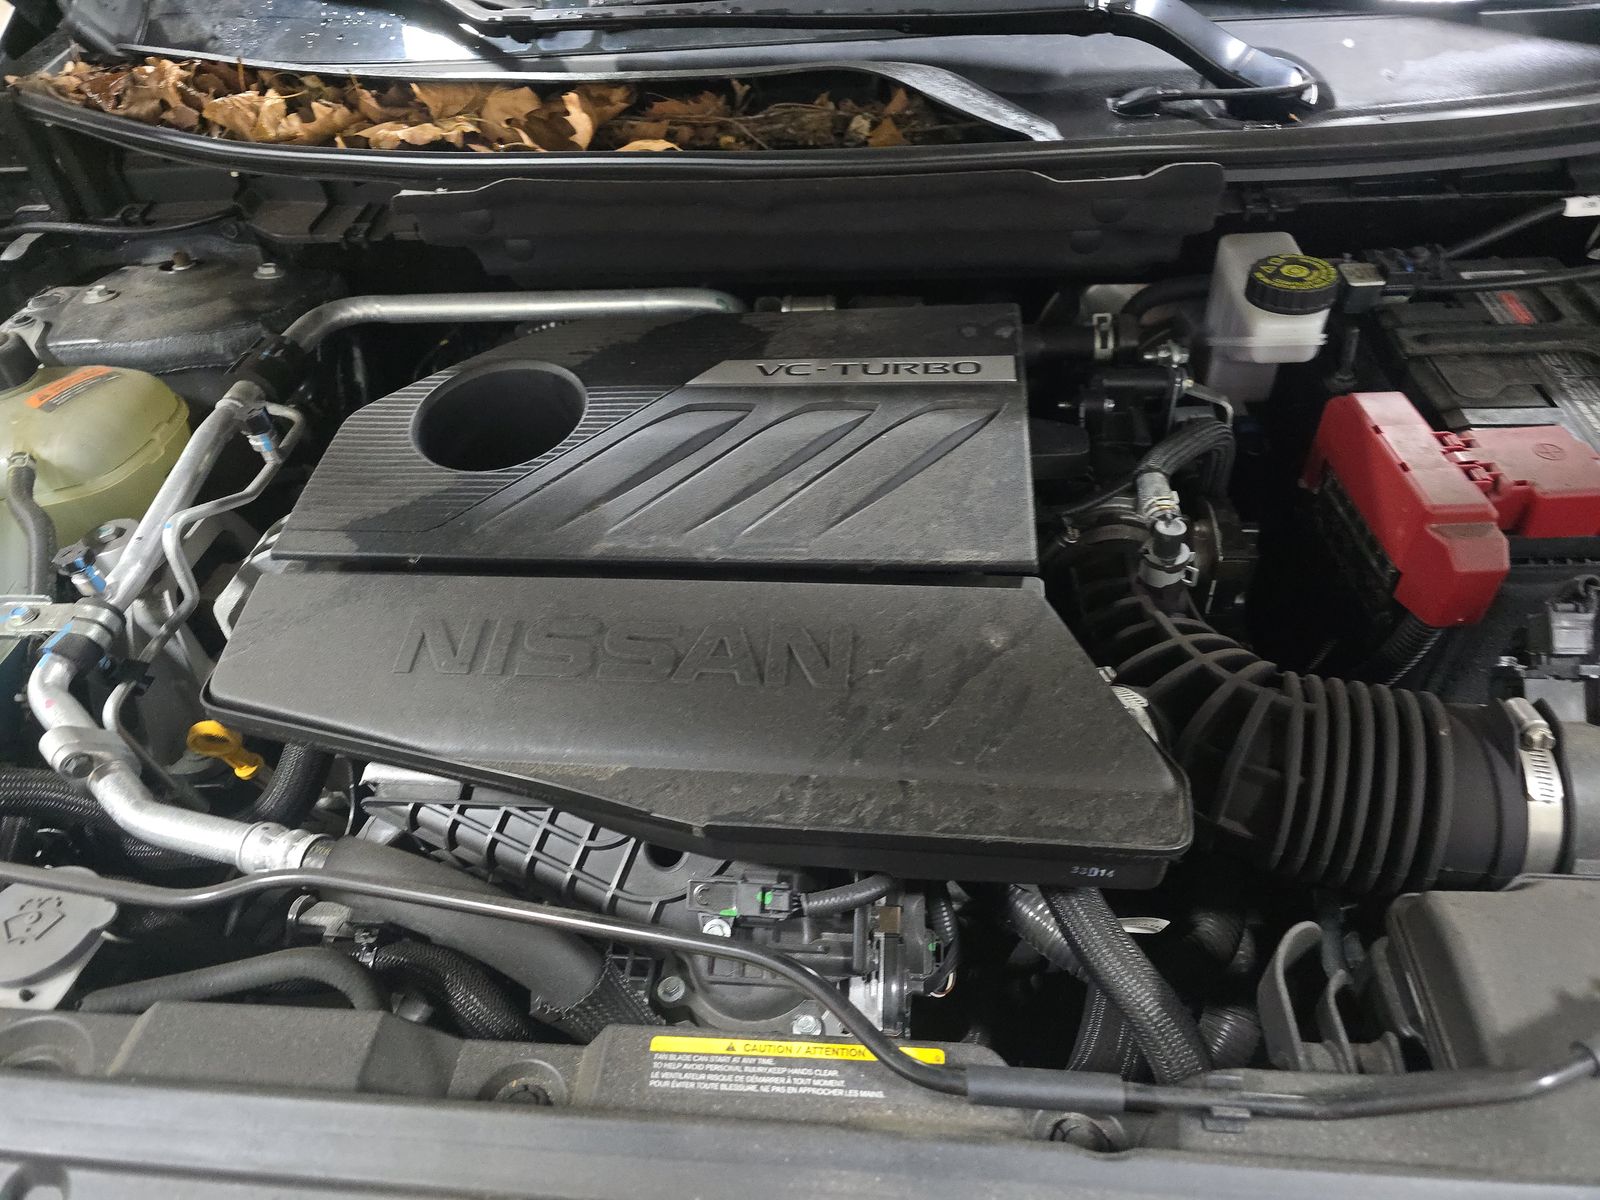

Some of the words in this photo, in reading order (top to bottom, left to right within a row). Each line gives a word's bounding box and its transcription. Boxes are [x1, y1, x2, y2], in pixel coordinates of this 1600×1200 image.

[755, 361, 982, 377] VC-TURBO
[393, 614, 856, 689] NISSAN
[743, 1043, 793, 1054] CAUTION
[805, 1046, 868, 1058] ATTENTION
[669, 1054, 692, 1062] BLADE
[692, 1054, 709, 1062] CAN
[709, 1055, 732, 1063] START
[731, 1056, 742, 1064] AT
[741, 1056, 757, 1064] ANY
[653, 1061, 663, 1069] TO
[663, 1062, 683, 1070] HELP
[682, 1062, 705, 1071] AVOID
[705, 1063, 743, 1072] PERSONAL
[787, 1067, 814, 1076] HANDS
[650, 1071, 660, 1079] LE
[660, 1071, 706, 1080] VENTILATEUR
[706, 1073, 734, 1082] RISQUE
[734, 1074, 745, 1083] DE
[792, 1077, 812, 1085] TOUT
[649, 1080, 671, 1088] POUR
[696, 1082, 720, 1090] TOUTE
[770, 1085, 786, 1094] PAS
[786, 1086, 798, 1094] EN
[798, 1086, 844, 1096] APPROCHER
[844, 1089, 859, 1098] LES
